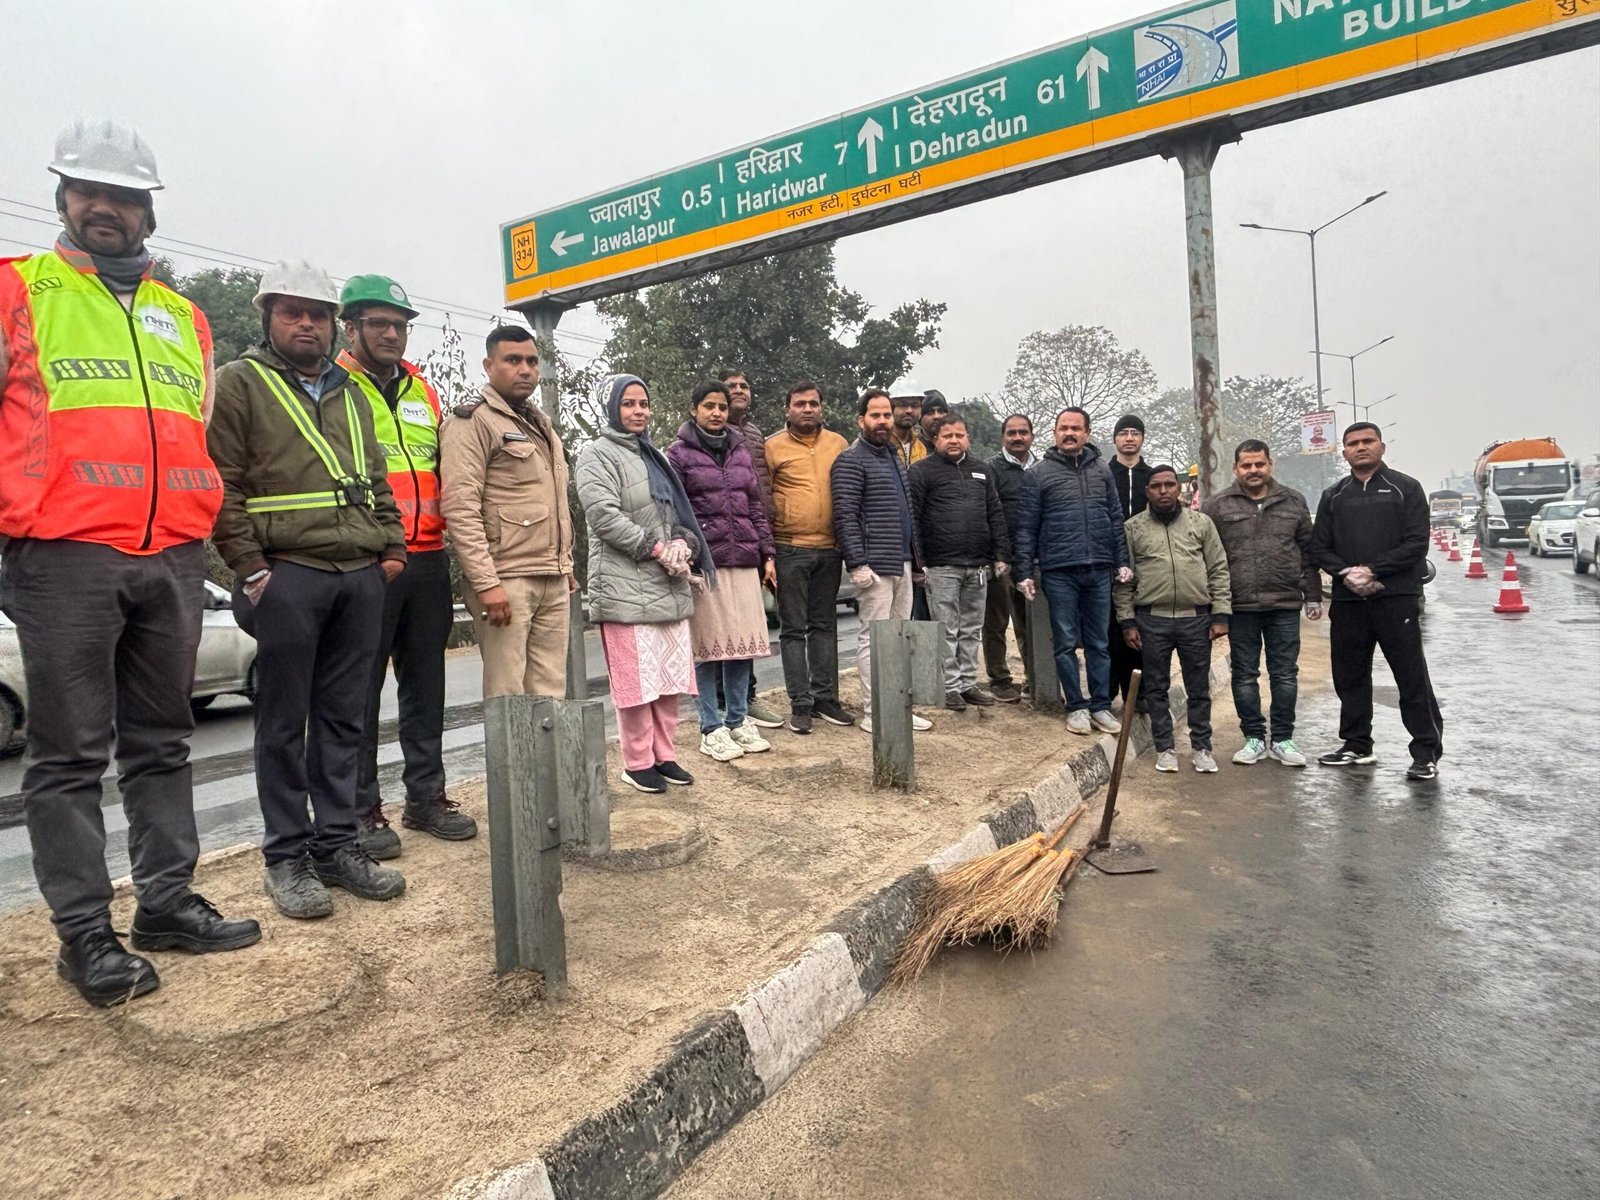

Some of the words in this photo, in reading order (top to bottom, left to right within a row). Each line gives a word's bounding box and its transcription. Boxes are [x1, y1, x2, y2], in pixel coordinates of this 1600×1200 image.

[908, 76, 1008, 127] देहरादून
[1037, 74, 1065, 105] 61
[1141, 73, 1166, 94] NHAI
[909, 114, 1028, 165] Dehradun
[735, 142, 803, 184] हरिद्वार
[834, 141, 848, 166] 7
[588, 187, 662, 224] ज्वालापुर
[681, 184, 713, 211] 0.5
[736, 173, 827, 215] Haridwar
[786, 204, 814, 220] नजर
[851, 183, 891, 207] दुर्घटना
[898, 171, 921, 189] घटी
[516, 247, 533, 262] 334
[517, 235, 530, 249] NH
[591, 217, 676, 256] Jawalapur
